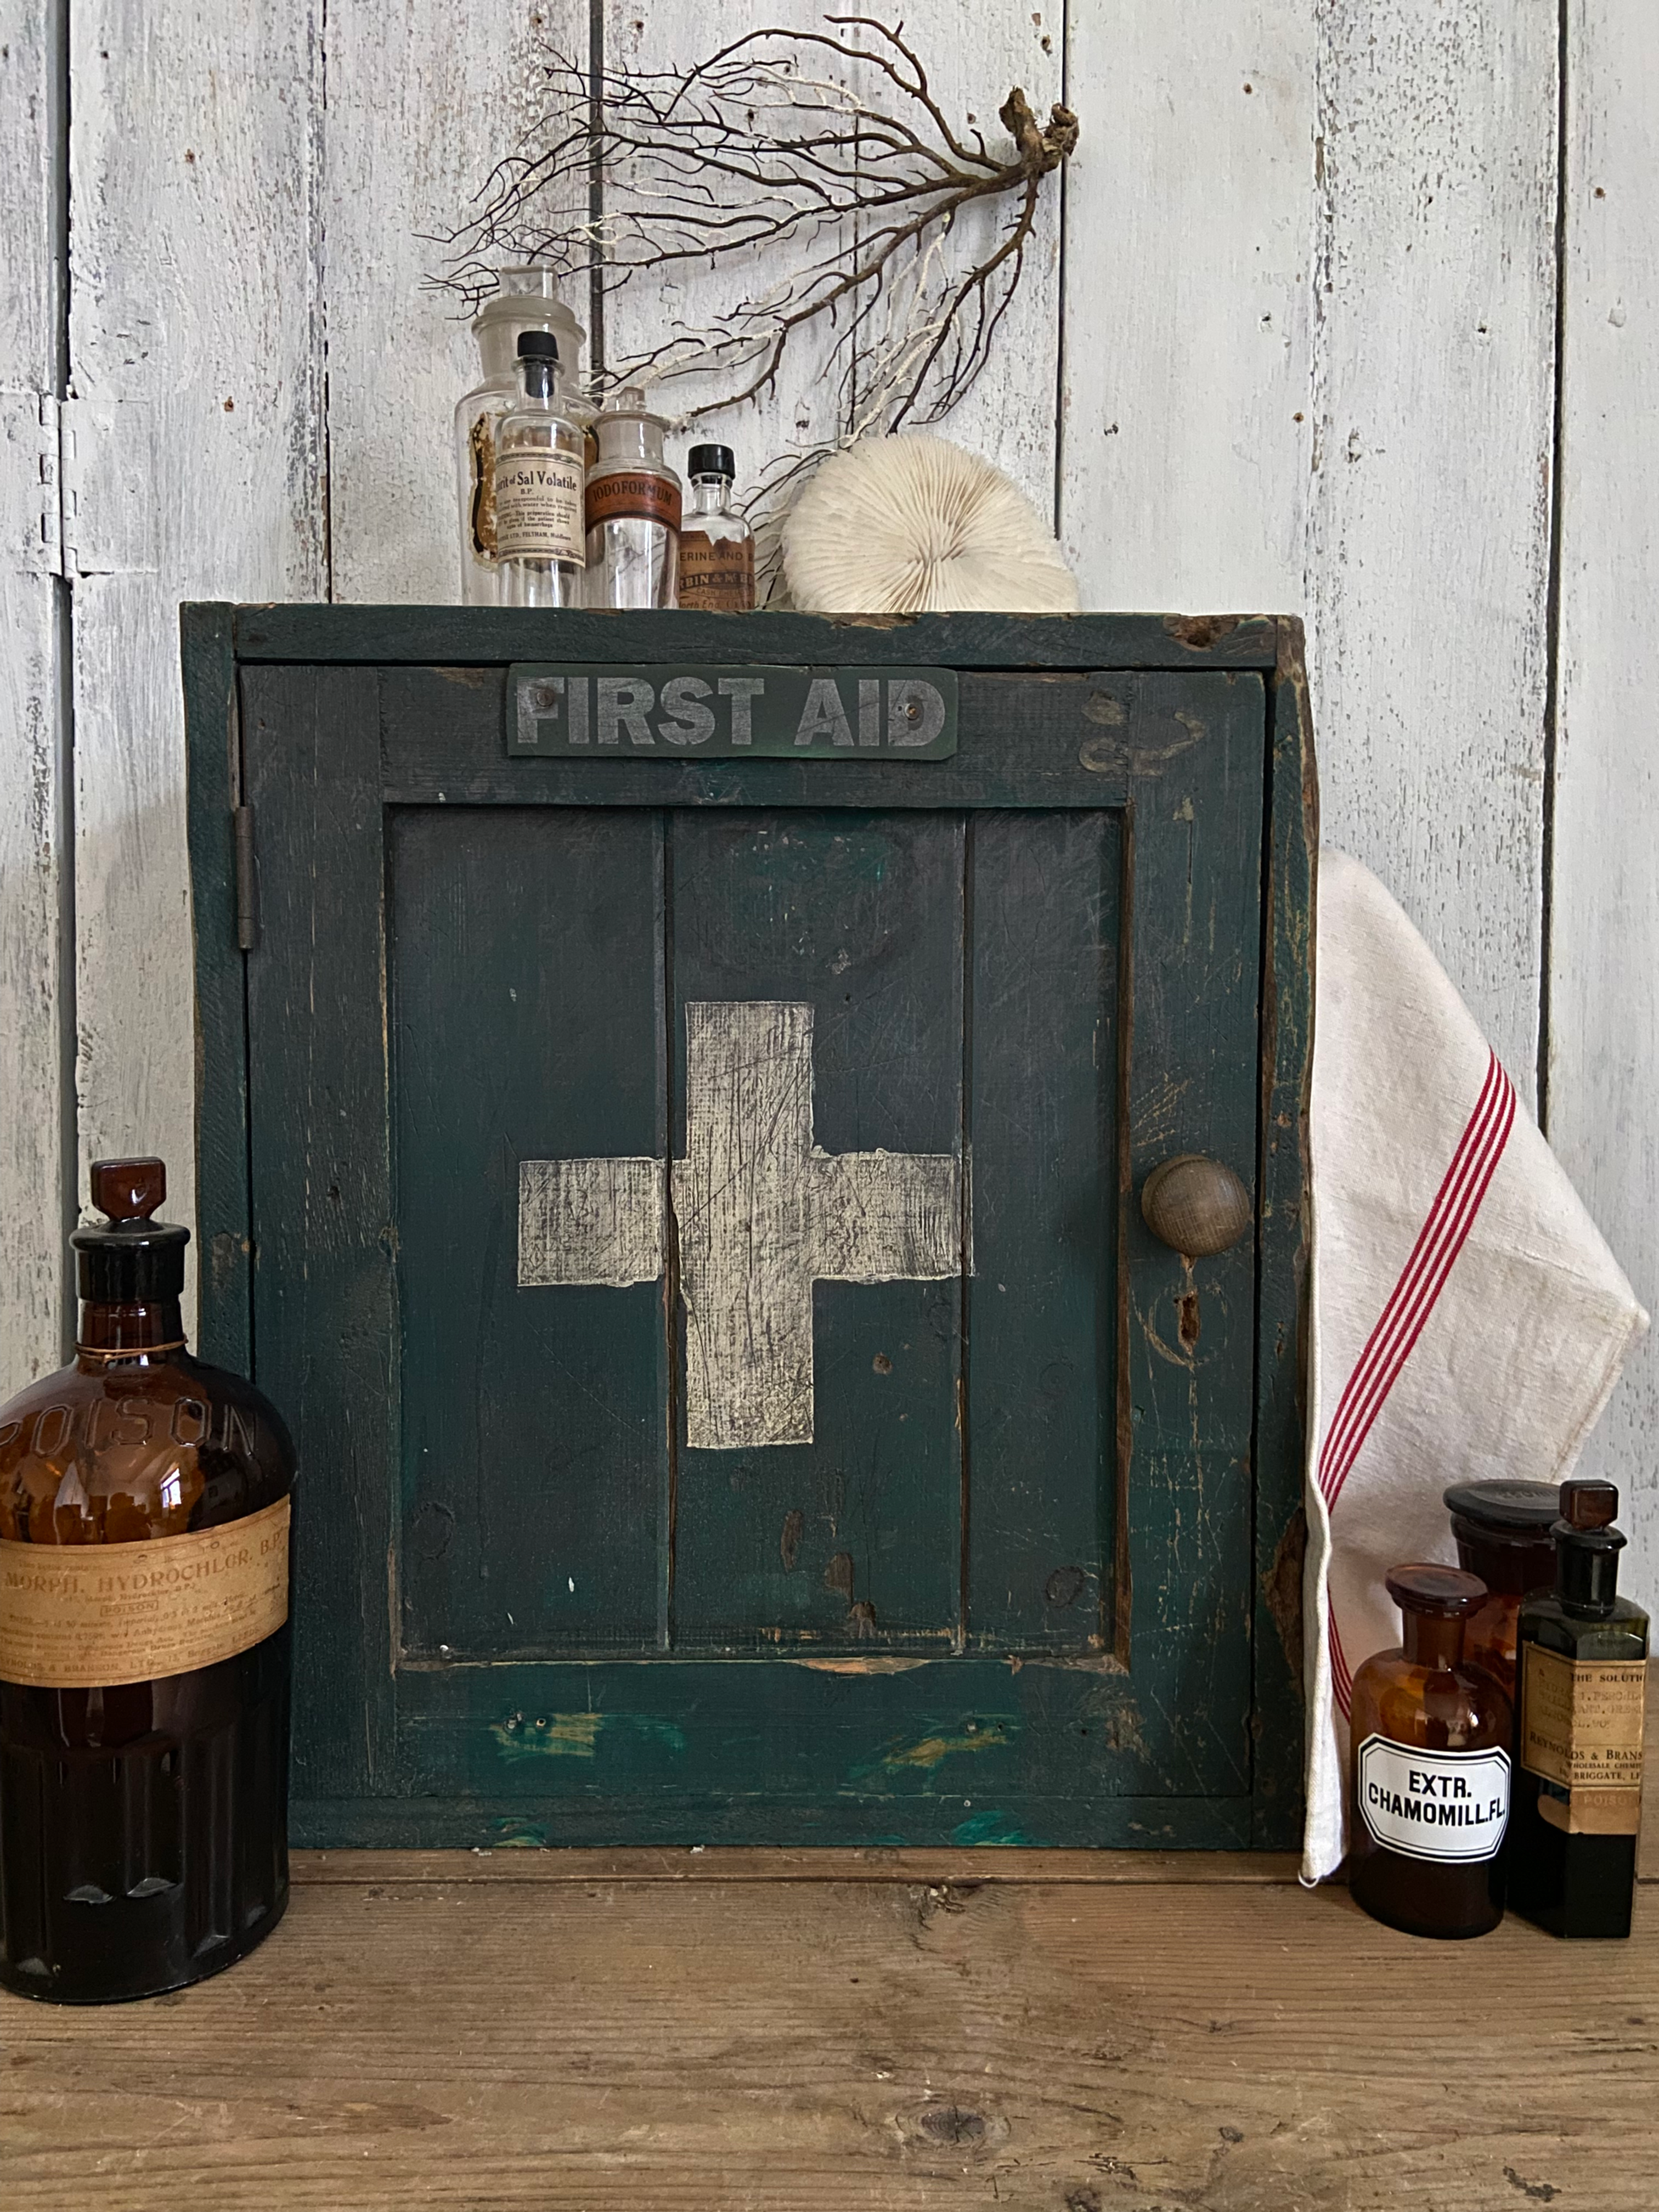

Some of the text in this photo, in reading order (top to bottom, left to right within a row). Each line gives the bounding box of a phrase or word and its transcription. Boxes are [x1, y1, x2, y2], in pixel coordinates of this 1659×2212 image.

[509, 475, 516, 485] of
[517, 471, 534, 486] Sal
[536, 470, 577, 492] Volatile
[593, 479, 672, 506] IODOFORMUM
[679, 552, 716, 561] ERINE
[719, 552, 743, 561] AND
[679, 574, 709, 589] RBIN
[517, 676, 945, 747] FIRST AID
[5, 1571, 85, 1594] MORPH.
[98, 1549, 253, 1594] HYDROCHLOR.
[105, 1601, 155, 1615] POISON
[1570, 1671, 1592, 1684] THE
[1530, 1730, 1643, 1760] REYNOLDS & BRANS
[1566, 1760, 1610, 1769] WHOLESALE
[1409, 1769, 1472, 1798] EXTR.
[1573, 1771, 1626, 1781] BRIGGATE,
